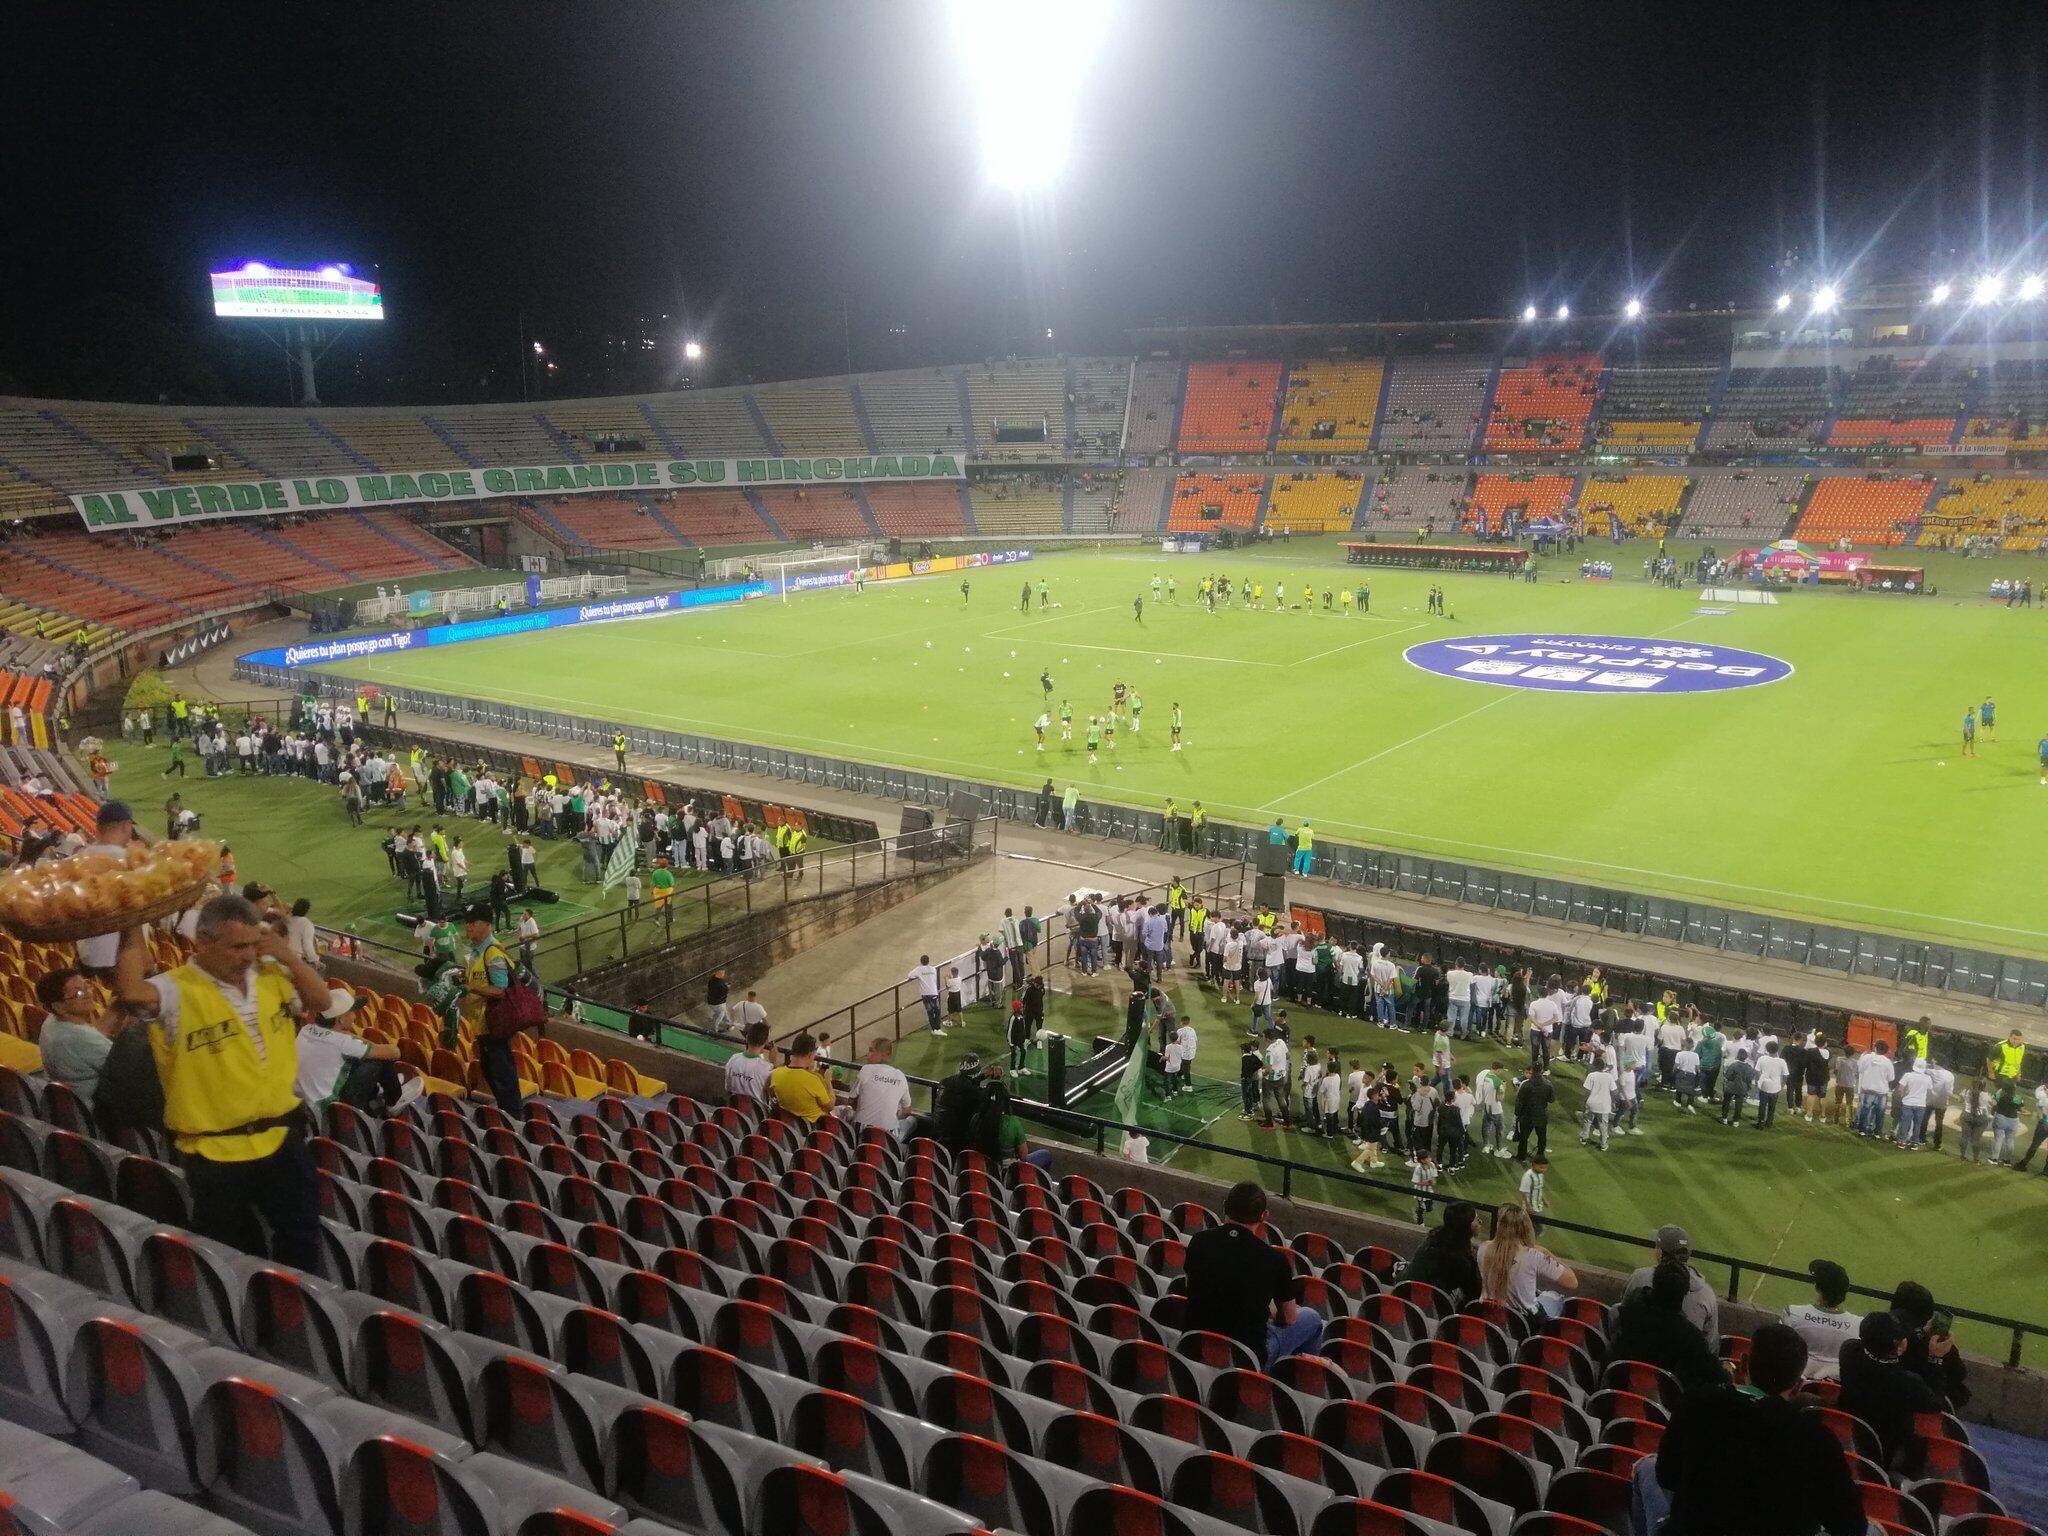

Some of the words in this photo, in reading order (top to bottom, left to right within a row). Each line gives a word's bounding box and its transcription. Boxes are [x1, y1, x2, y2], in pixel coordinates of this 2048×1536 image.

[1973, 445, 2006, 453] violencia
[82, 494, 138, 526] AL
[138, 481, 289, 519] VERDE
[292, 478, 350, 504] LO
[355, 471, 476, 501] HACE
[482, 463, 661, 492] GRANDE
[667, 460, 725, 483] SU
[737, 455, 960, 482] HINCHADA
[580, 605, 604, 620] ¿Quieres
[603, 605, 610, 615] tu
[610, 602, 623, 617] plan
[622, 601, 645, 615] pospago
[644, 599, 655, 609] con
[654, 595, 669, 610] Tigo?
[447, 626, 474, 642] ¿Quieres
[473, 625, 482, 635] tu
[482, 622, 497, 637] plan
[497, 619, 523, 634] pospago
[522, 618, 534, 628] con
[534, 614, 549, 629] Tigo?
[285, 645, 319, 664] ¿Quieres
[319, 644, 328, 656] tu
[329, 641, 347, 658] plan
[378, 638, 392, 647] con
[392, 632, 411, 649] Tigo?
[1505, 649, 1768, 678] BetPlay
[1804, 1312, 1843, 1330] BetPlay
